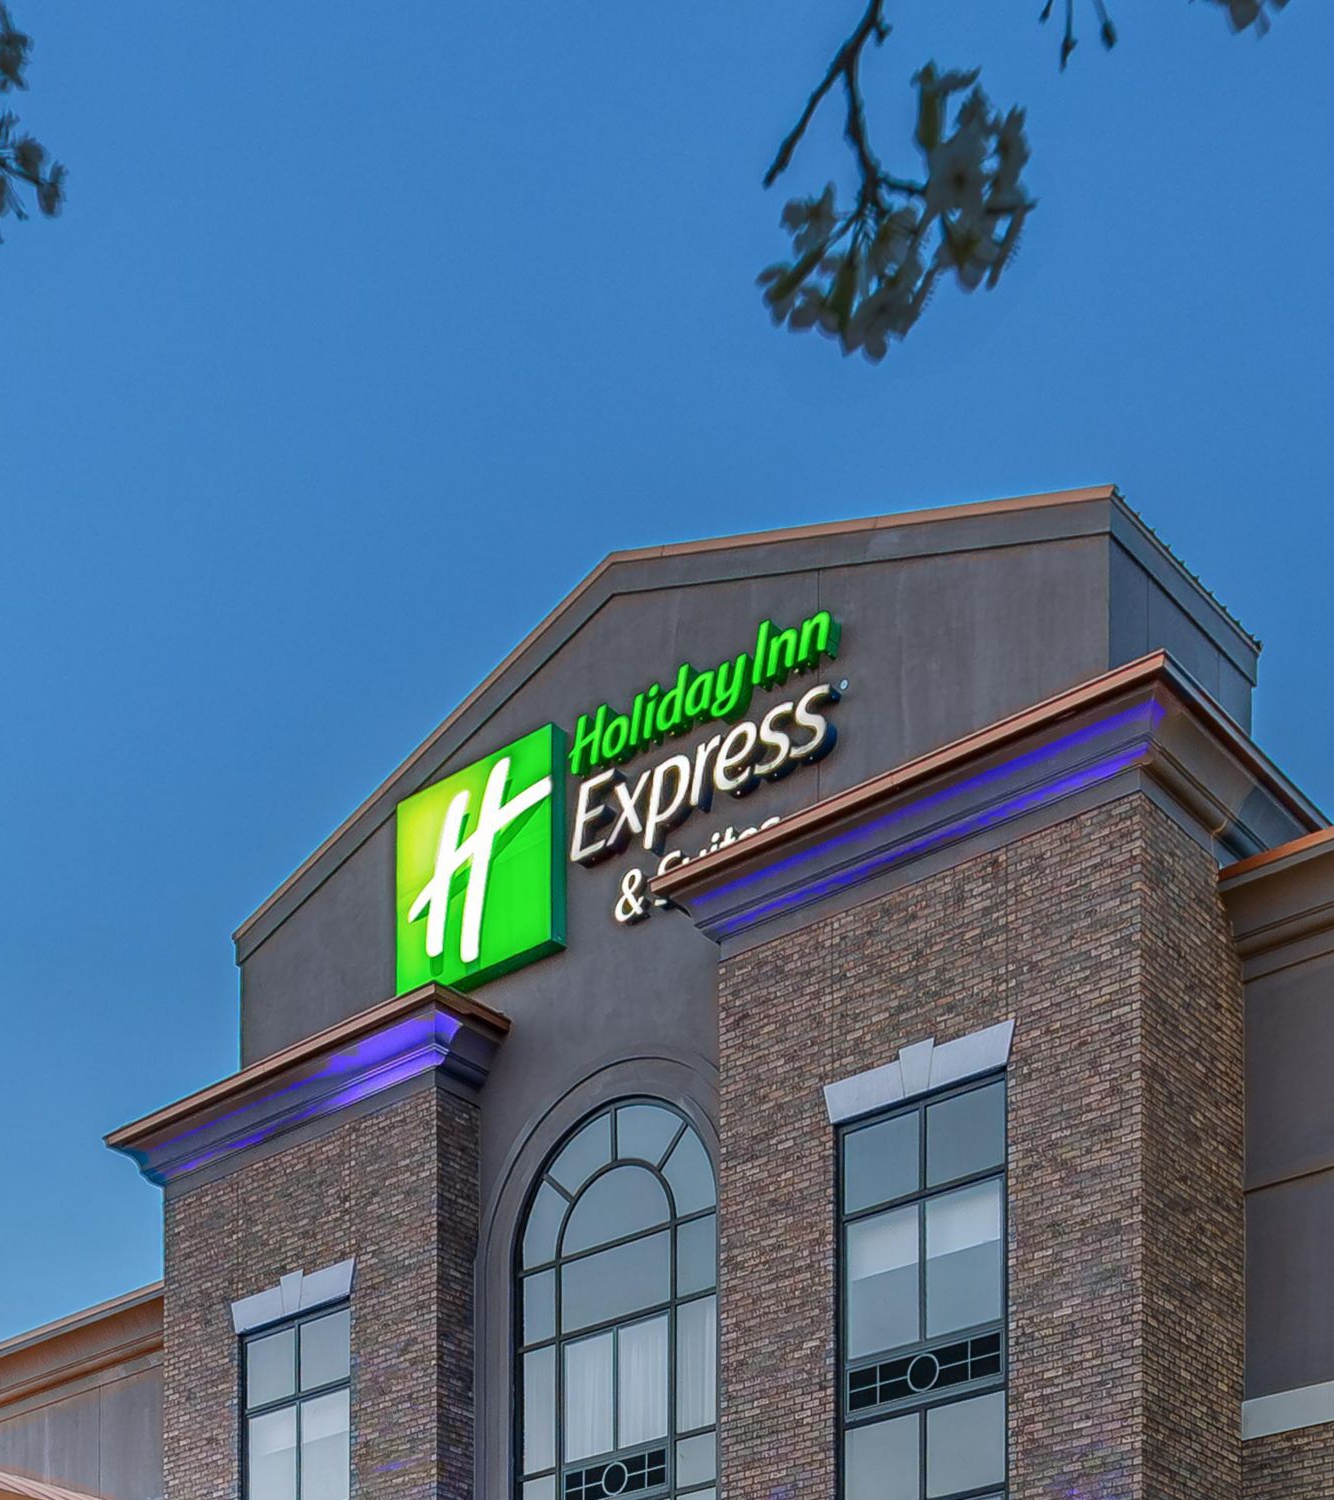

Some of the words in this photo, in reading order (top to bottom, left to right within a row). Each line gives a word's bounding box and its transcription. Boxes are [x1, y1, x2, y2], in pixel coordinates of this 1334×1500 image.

[569, 651, 747, 774] Holiday
[751, 610, 832, 686] Inn
[570, 684, 830, 863] Express
[614, 867, 645, 923] &
